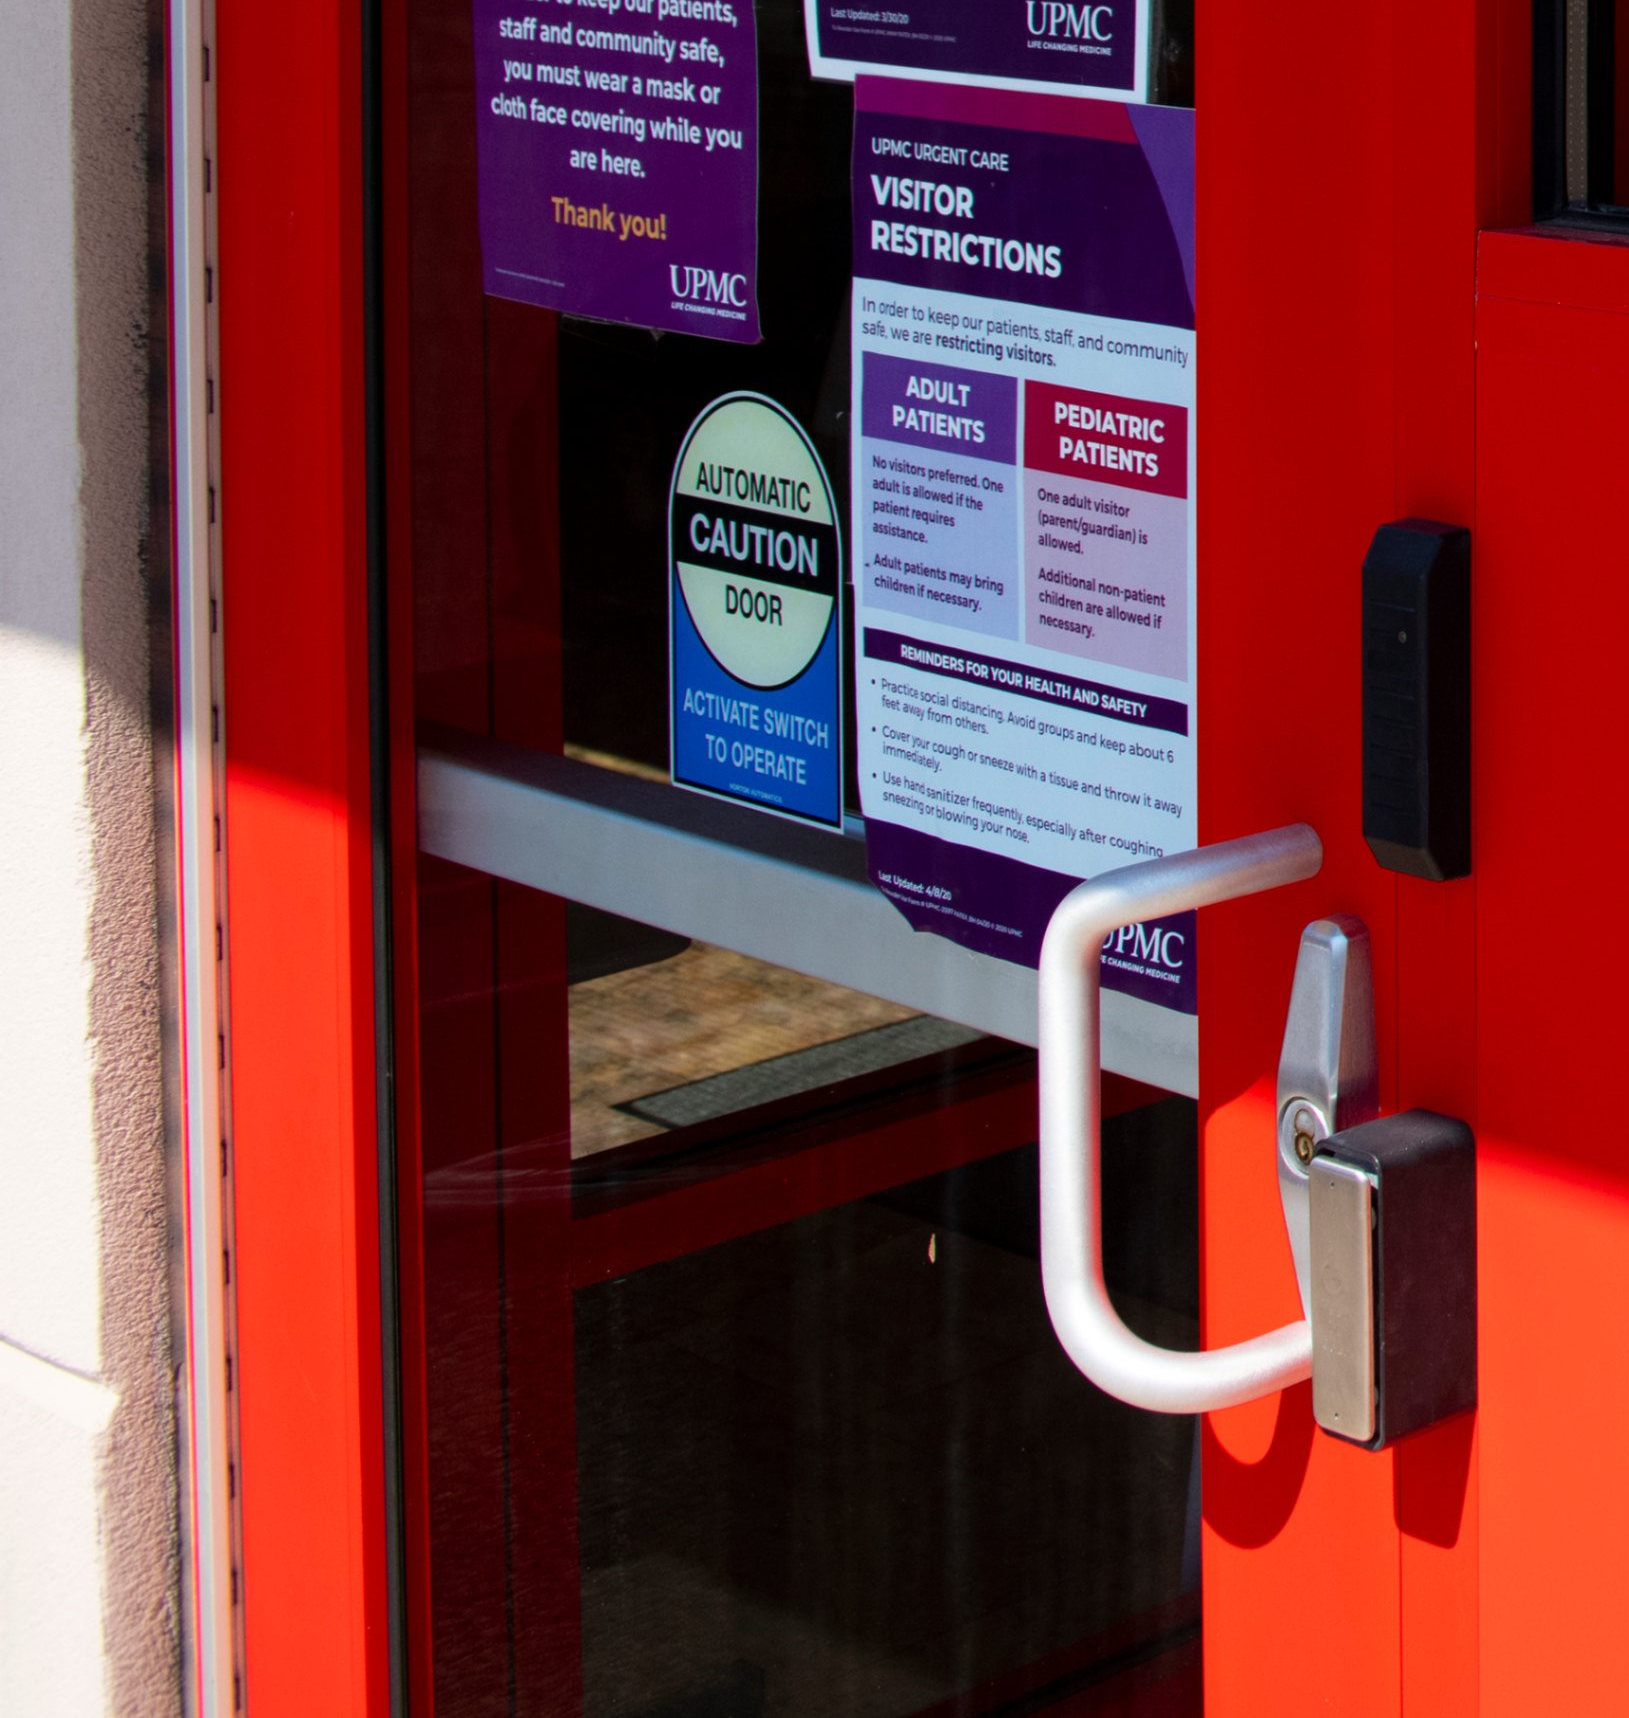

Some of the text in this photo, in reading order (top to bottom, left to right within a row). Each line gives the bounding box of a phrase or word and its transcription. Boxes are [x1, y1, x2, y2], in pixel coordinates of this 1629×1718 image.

[1026, 0, 1112, 41] UPMC
[499, 17, 724, 68] staff and community safe,
[504, 60, 721, 104] you must wear a mask or
[491, 93, 742, 151] cloth face covering while you
[570, 148, 645, 177] are here.
[872, 137, 1009, 171] UPMC URGENT CARE
[871, 175, 973, 218] VISITOR
[552, 197, 666, 241] Thank you!
[872, 220, 1061, 277] RESTRICTIONS
[670, 265, 746, 307] UPMC
[906, 376, 970, 406] ADULT
[893, 405, 985, 443] PATIENTS
[1055, 402, 1164, 443] PEDIATRIC
[1060, 436, 1158, 476] PATIENTS
[696, 462, 810, 513] AUTOMATIC
[690, 513, 817, 576] CAUTION
[726, 584, 782, 626] DOOR
[684, 688, 828, 748] ACTIVATE SWITCH
[705, 734, 806, 785] TO OPERATE
